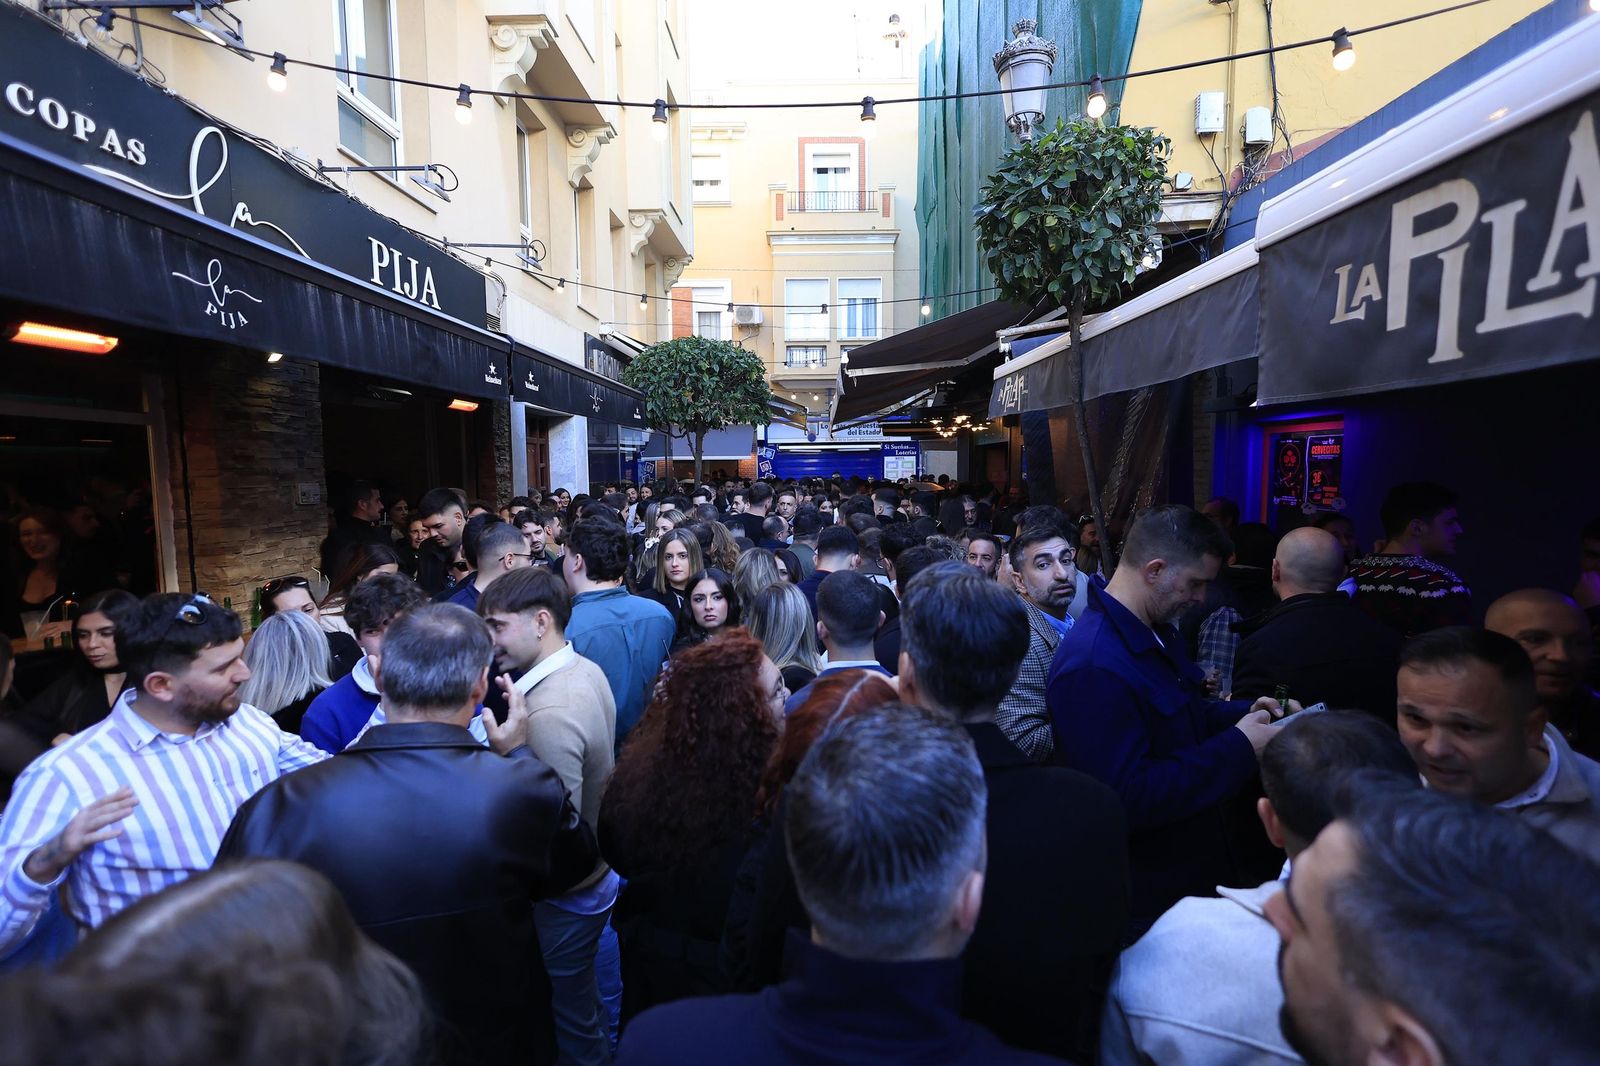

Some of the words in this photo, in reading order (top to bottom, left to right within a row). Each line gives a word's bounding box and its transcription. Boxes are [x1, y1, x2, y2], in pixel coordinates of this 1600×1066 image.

[4, 82, 148, 166] COPAS
[367, 236, 442, 311] PIJA
[1330, 263, 1383, 325] LA
[203, 300, 250, 330] PIJA
